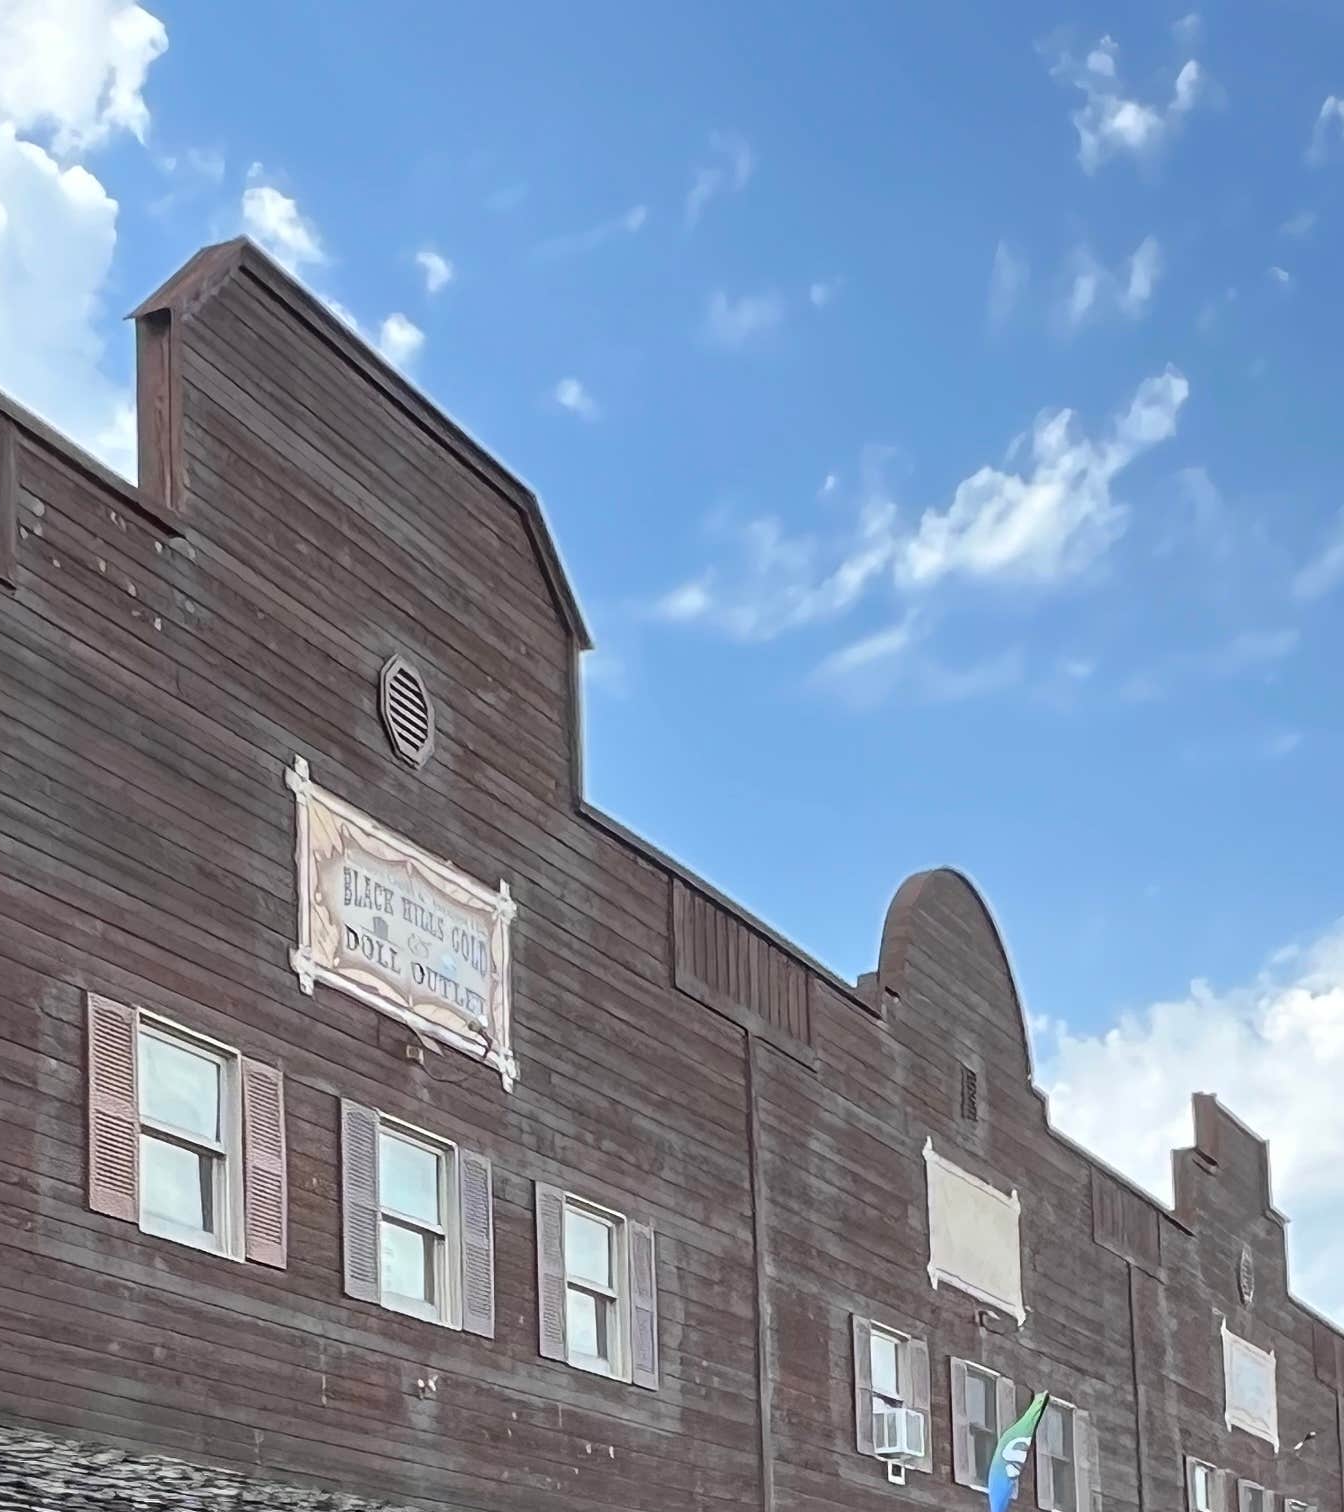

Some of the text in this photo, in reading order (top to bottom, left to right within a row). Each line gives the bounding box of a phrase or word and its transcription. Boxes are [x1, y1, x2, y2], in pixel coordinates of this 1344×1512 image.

[343, 866, 488, 978] BLACK HILLS GOLD
[344, 923, 487, 1016] DOLL OUTLET
